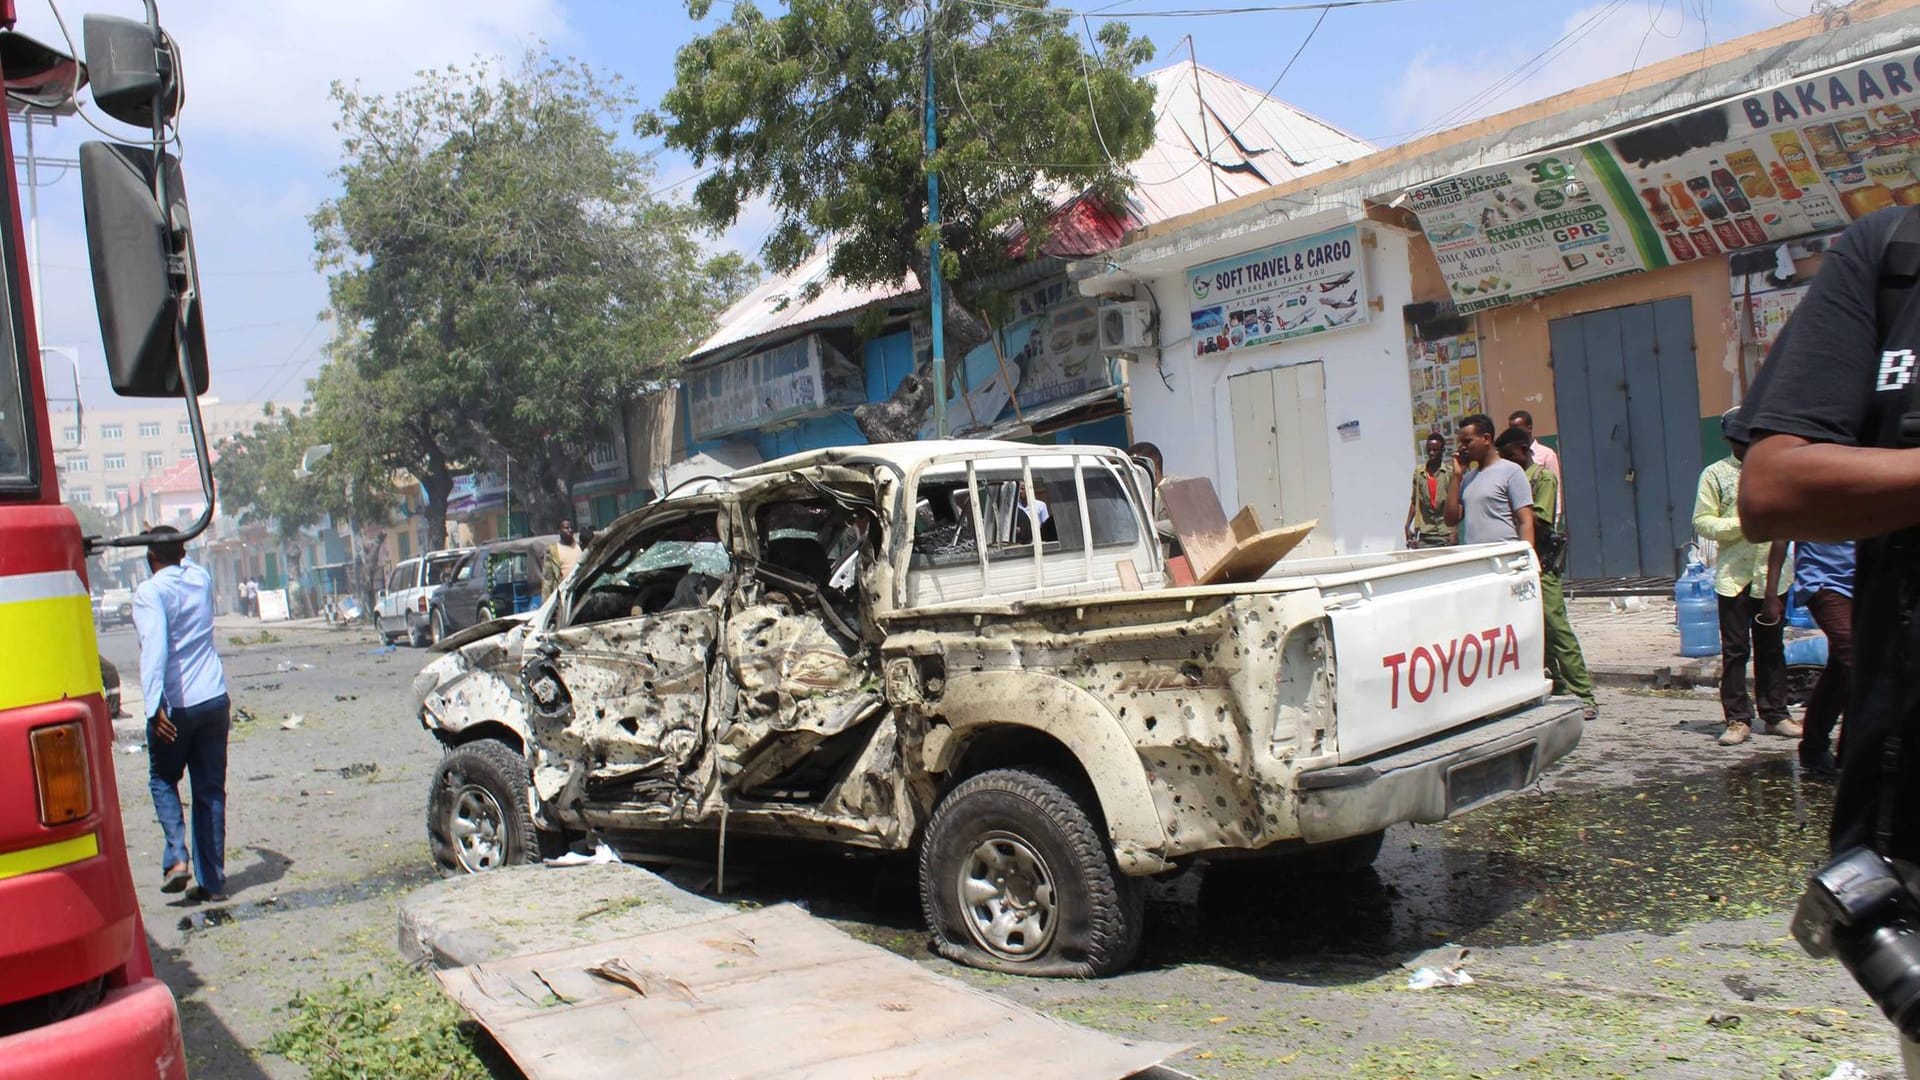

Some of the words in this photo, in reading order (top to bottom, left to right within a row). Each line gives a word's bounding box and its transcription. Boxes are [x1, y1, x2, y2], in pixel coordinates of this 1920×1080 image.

[1743, 55, 1920, 129] BAKAAR
[1486, 171, 1509, 184] PLUS
[1524, 158, 1568, 183] 3G
[1413, 193, 1462, 211] HORMUUD
[1552, 219, 1610, 243] GPRS
[1216, 267, 1244, 291] SOFT
[1246, 255, 1291, 283] TRAVEL
[1294, 252, 1304, 271] &
[1307, 240, 1351, 268] CARGO
[1236, 283, 1262, 295] WHERE
[1283, 274, 1304, 285] TAKE
[1308, 268, 1326, 278] YOU
[1383, 624, 1520, 709] TOYOTA
